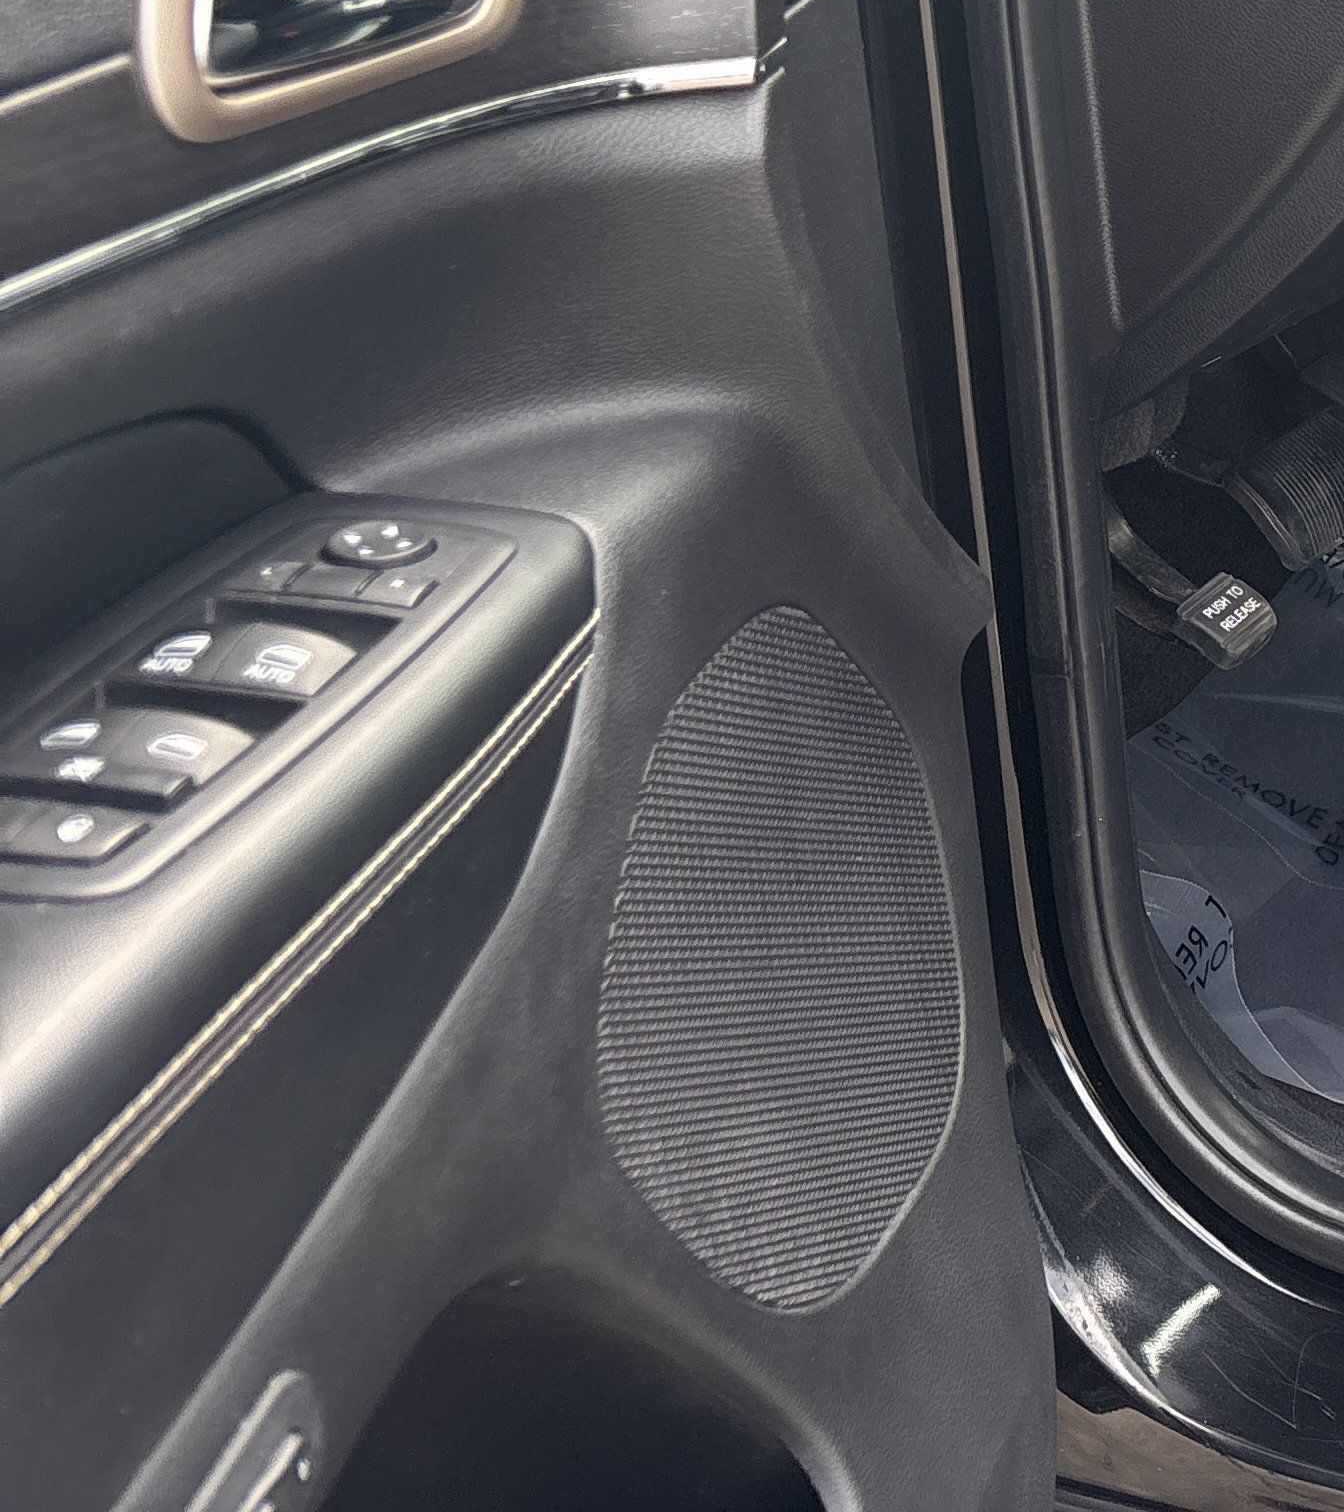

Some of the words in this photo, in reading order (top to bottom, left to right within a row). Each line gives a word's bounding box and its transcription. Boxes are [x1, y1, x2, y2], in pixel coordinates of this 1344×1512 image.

[1202, 595, 1232, 620] PUSH
[1225, 585, 1244, 604] TO
[1219, 597, 1261, 632] RELEASE
[138, 657, 193, 673] AUTO
[242, 663, 296, 684] AUTO
